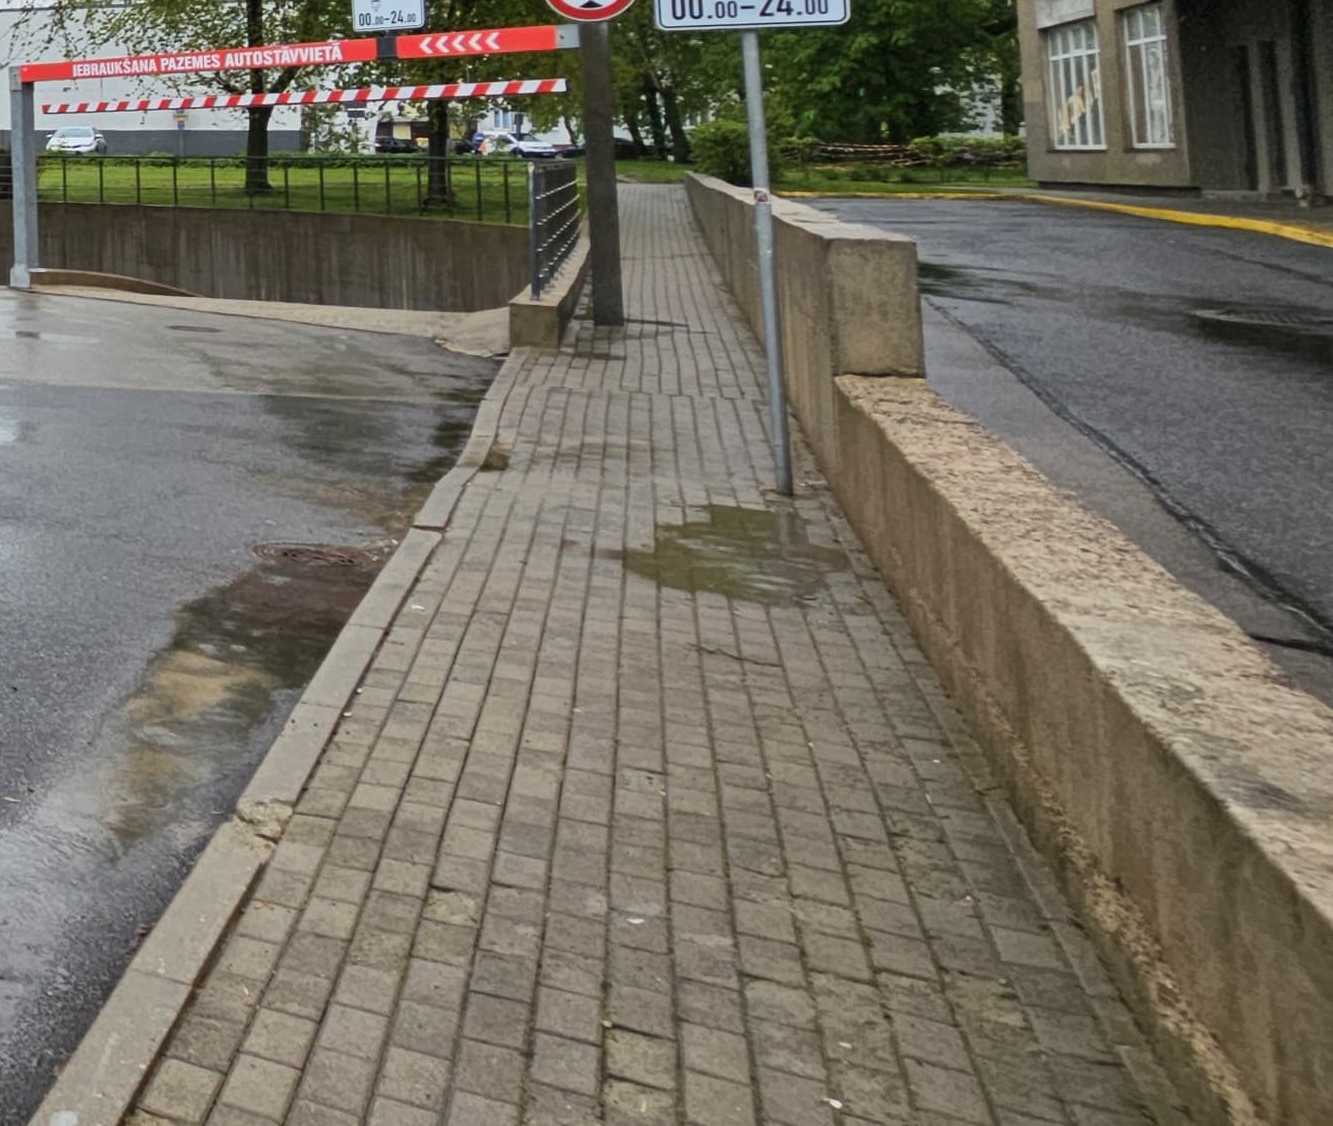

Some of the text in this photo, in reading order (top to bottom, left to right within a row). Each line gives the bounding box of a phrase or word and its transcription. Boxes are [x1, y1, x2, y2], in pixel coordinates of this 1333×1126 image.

[72, 43, 343, 77] IEBRAUKŠANA PAZEMES AUTOSTĀVVIETĀ
